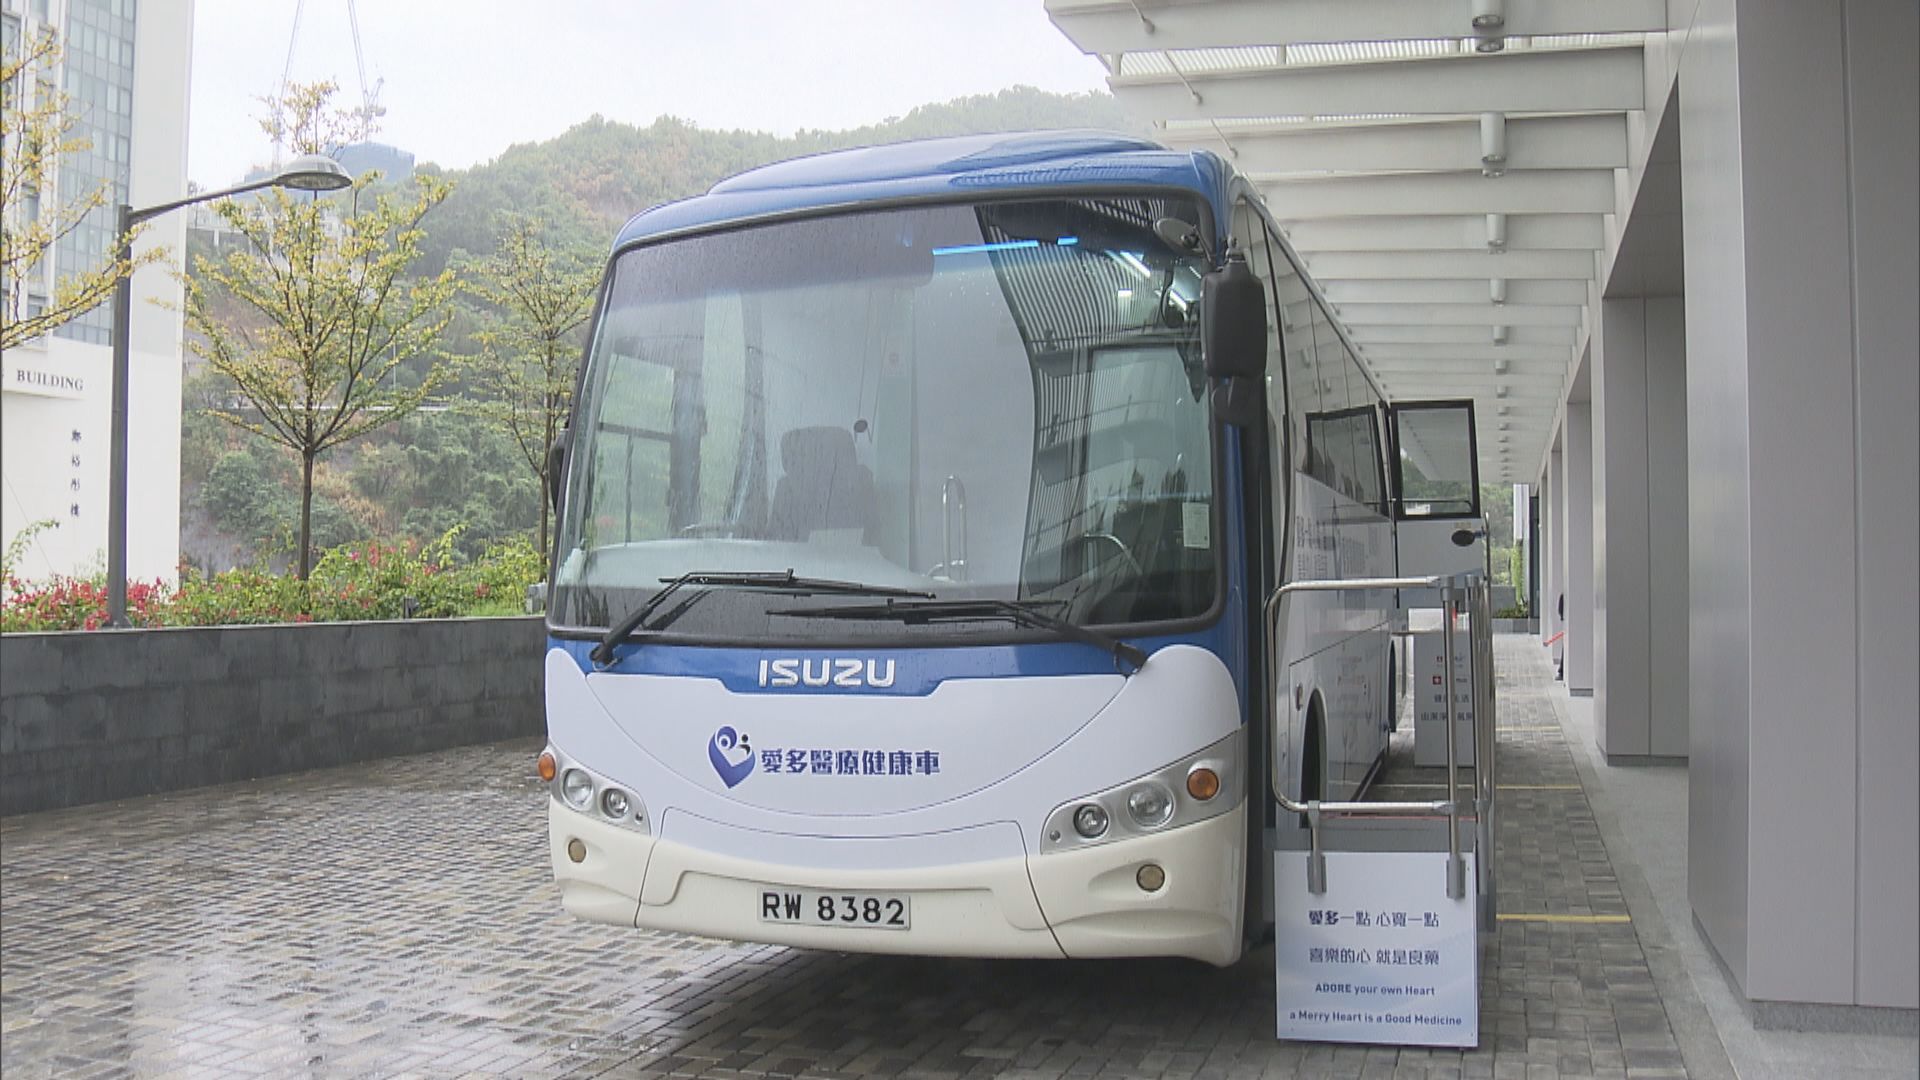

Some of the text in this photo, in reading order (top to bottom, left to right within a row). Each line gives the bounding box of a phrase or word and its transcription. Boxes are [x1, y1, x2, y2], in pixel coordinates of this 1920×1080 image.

[17, 369, 84, 391] BUILDING
[758, 658, 896, 688] ISUZU
[761, 748, 941, 776] 愛多醫療健康車
[762, 891, 905, 926] RW 8382
[1309, 948, 1440, 966] 喜樂的心 就是良藥
[1315, 983, 1435, 996] ADORE your own Heart
[1289, 1011, 1462, 1025] a Merry Heart is a Good Medicine
